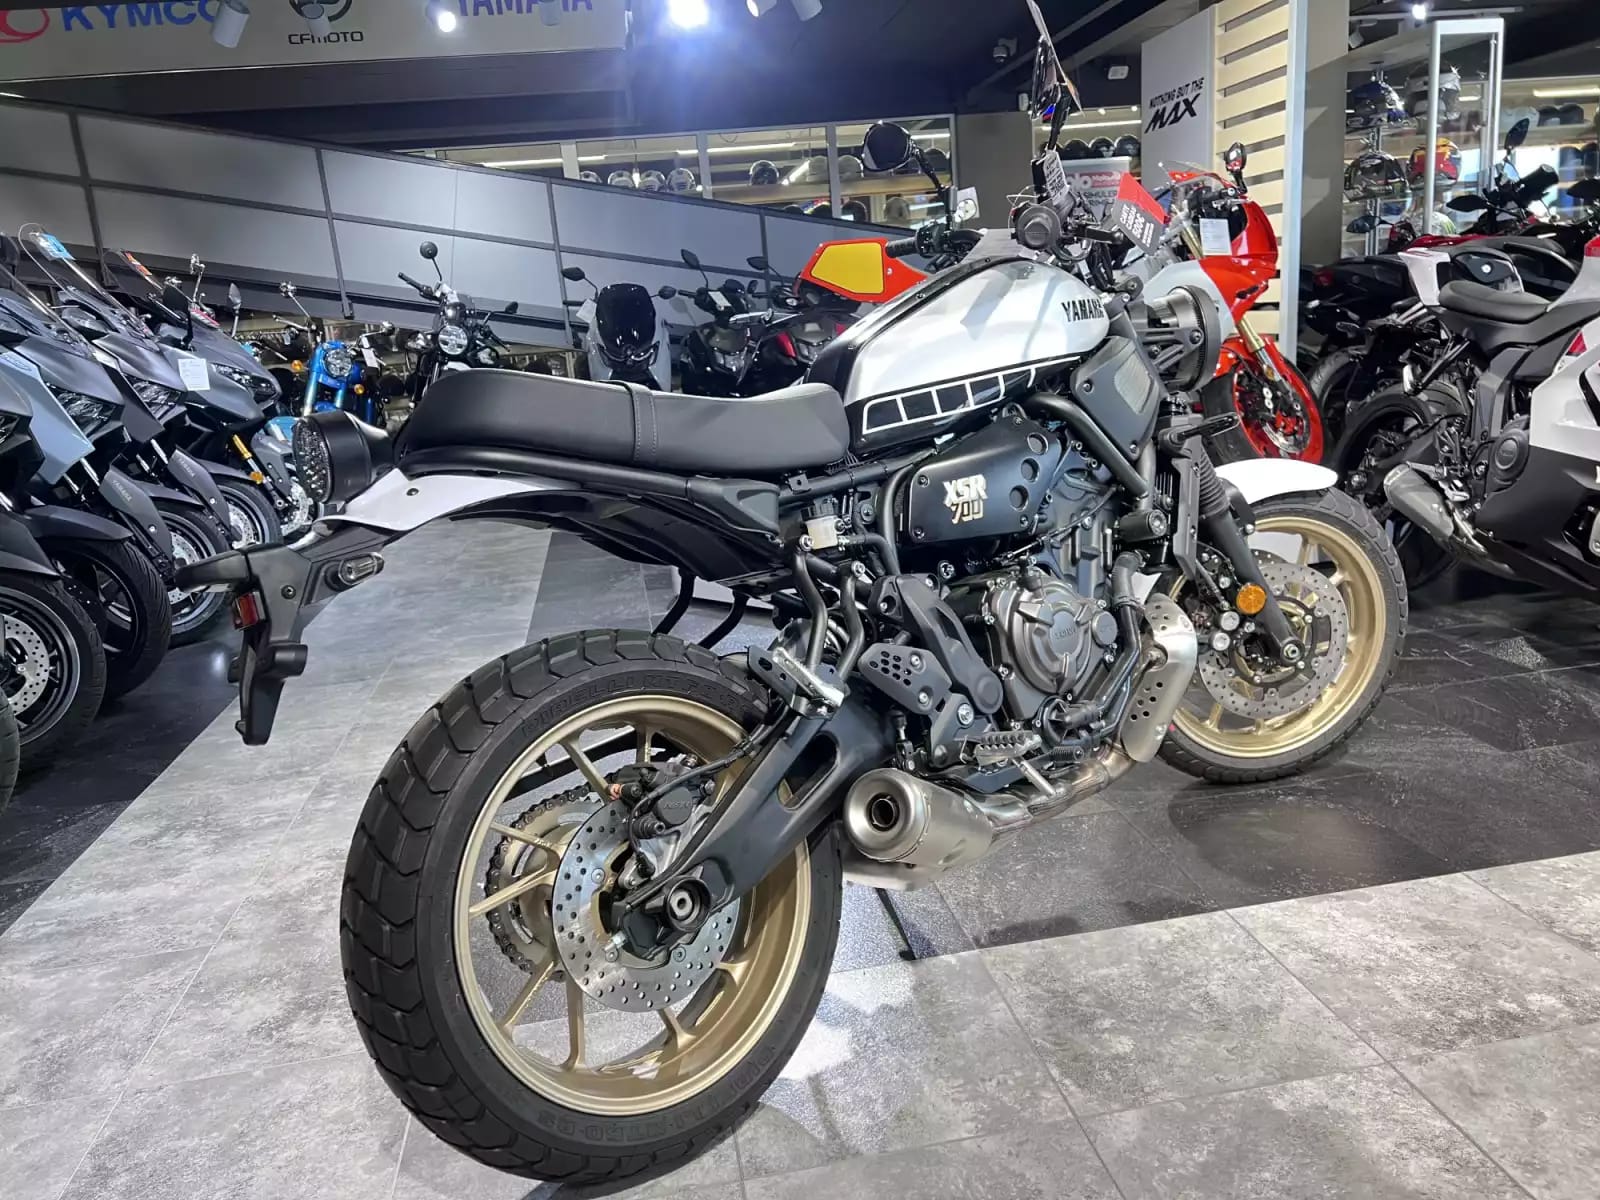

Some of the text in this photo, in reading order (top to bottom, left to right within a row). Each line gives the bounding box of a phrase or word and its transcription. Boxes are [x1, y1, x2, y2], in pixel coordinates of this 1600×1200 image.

[1144, 93, 1201, 134] MAX
[1061, 298, 1105, 322] YAMAHA
[942, 473, 988, 507] XSR
[950, 499, 984, 524] 700
